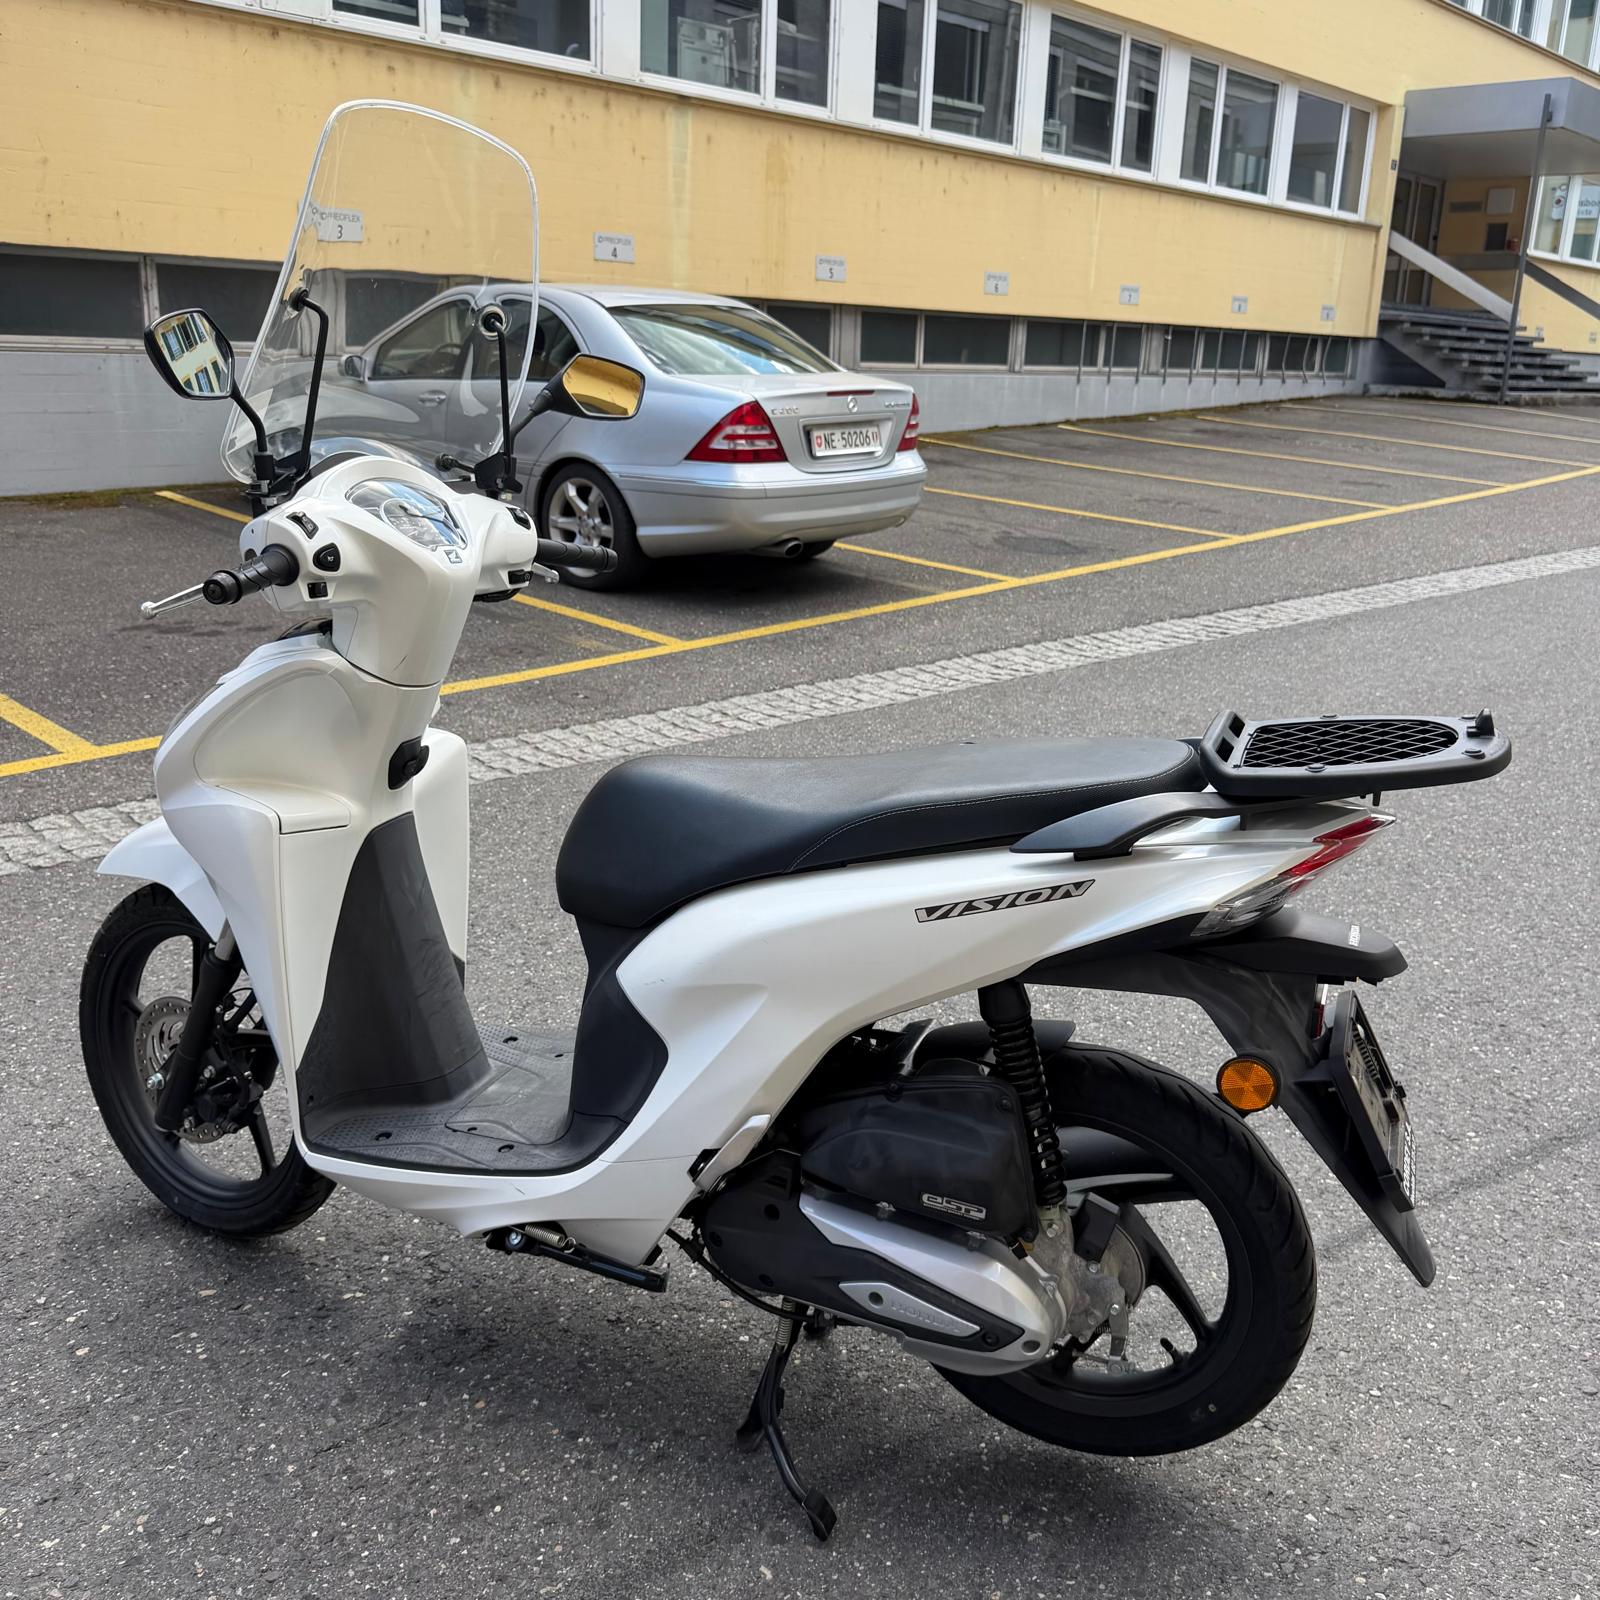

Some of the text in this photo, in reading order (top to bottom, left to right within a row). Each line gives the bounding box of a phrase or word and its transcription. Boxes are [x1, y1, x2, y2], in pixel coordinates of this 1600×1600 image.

[337, 224, 344, 240] 3
[611, 247, 618, 258] 4
[828, 267, 834, 280] 5
[915, 879, 1096, 923] VISION
